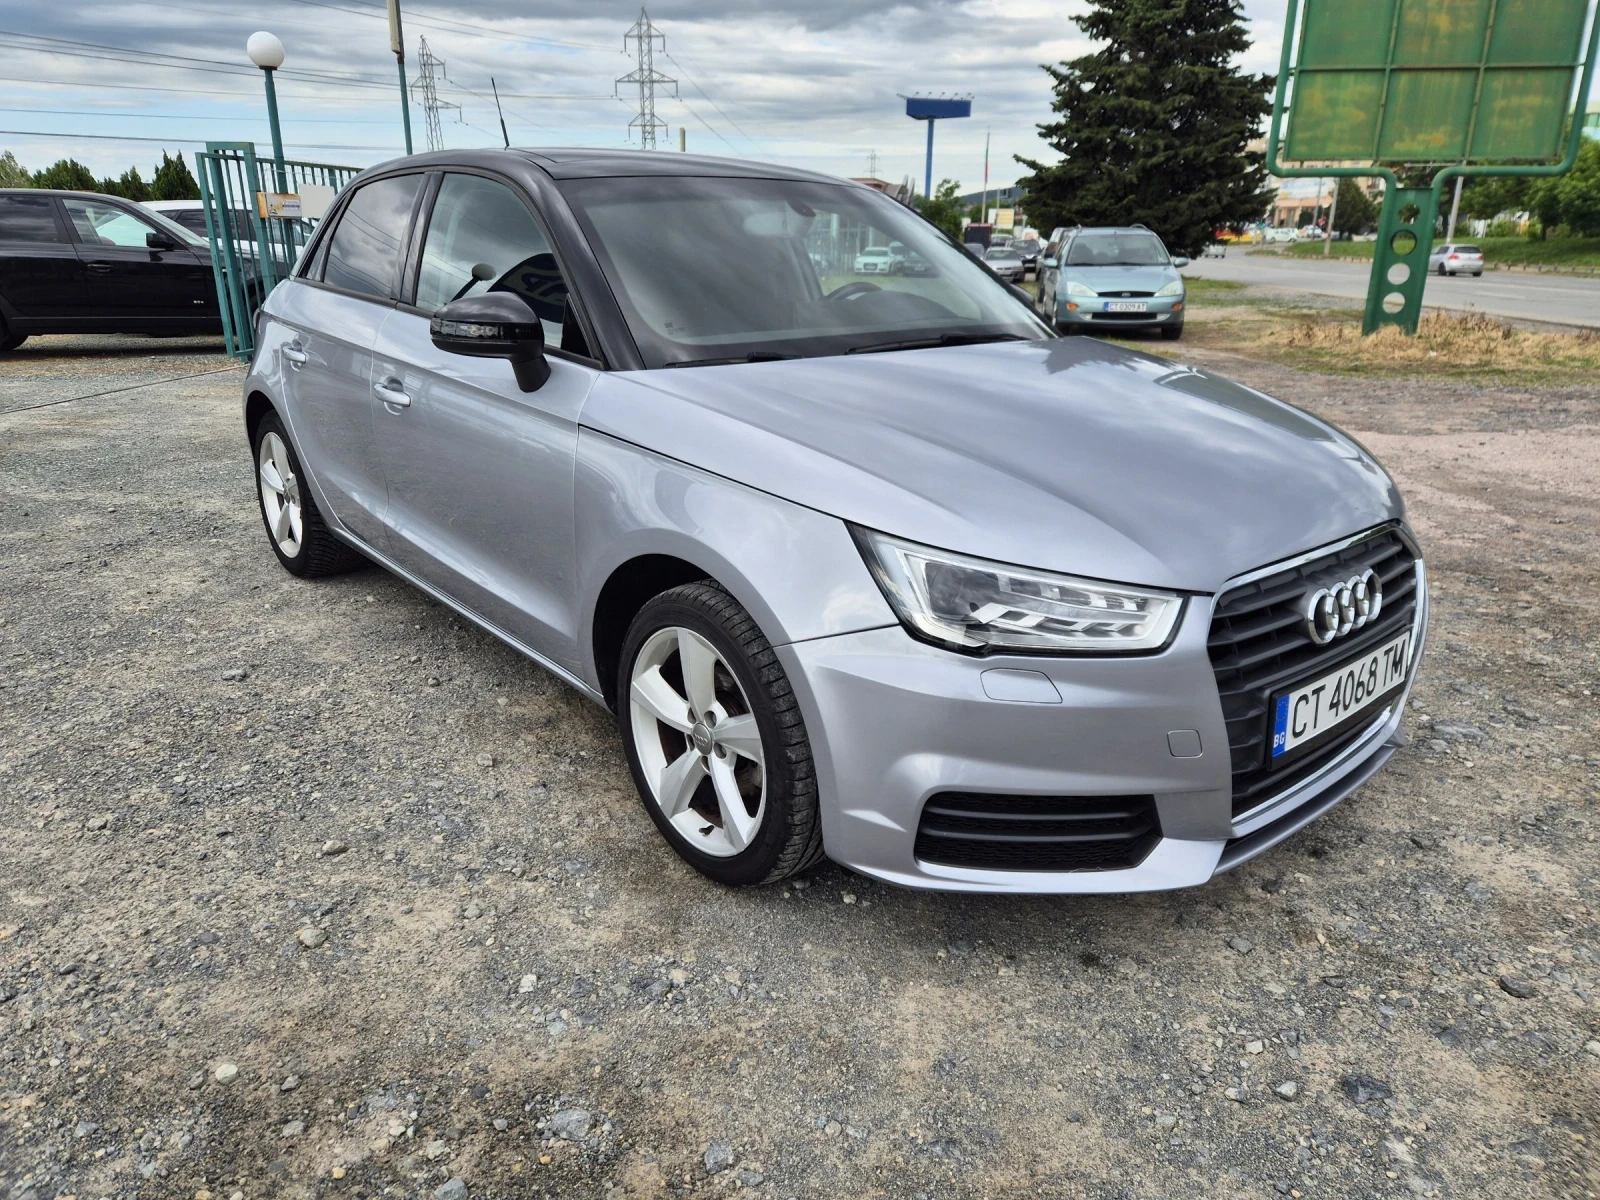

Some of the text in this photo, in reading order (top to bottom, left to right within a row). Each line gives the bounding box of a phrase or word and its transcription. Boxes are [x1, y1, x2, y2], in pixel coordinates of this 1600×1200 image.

[1109, 303, 1118, 311] CT
[1292, 639, 1406, 738] CT 4068 TM
[1273, 731, 1285, 748] BG
